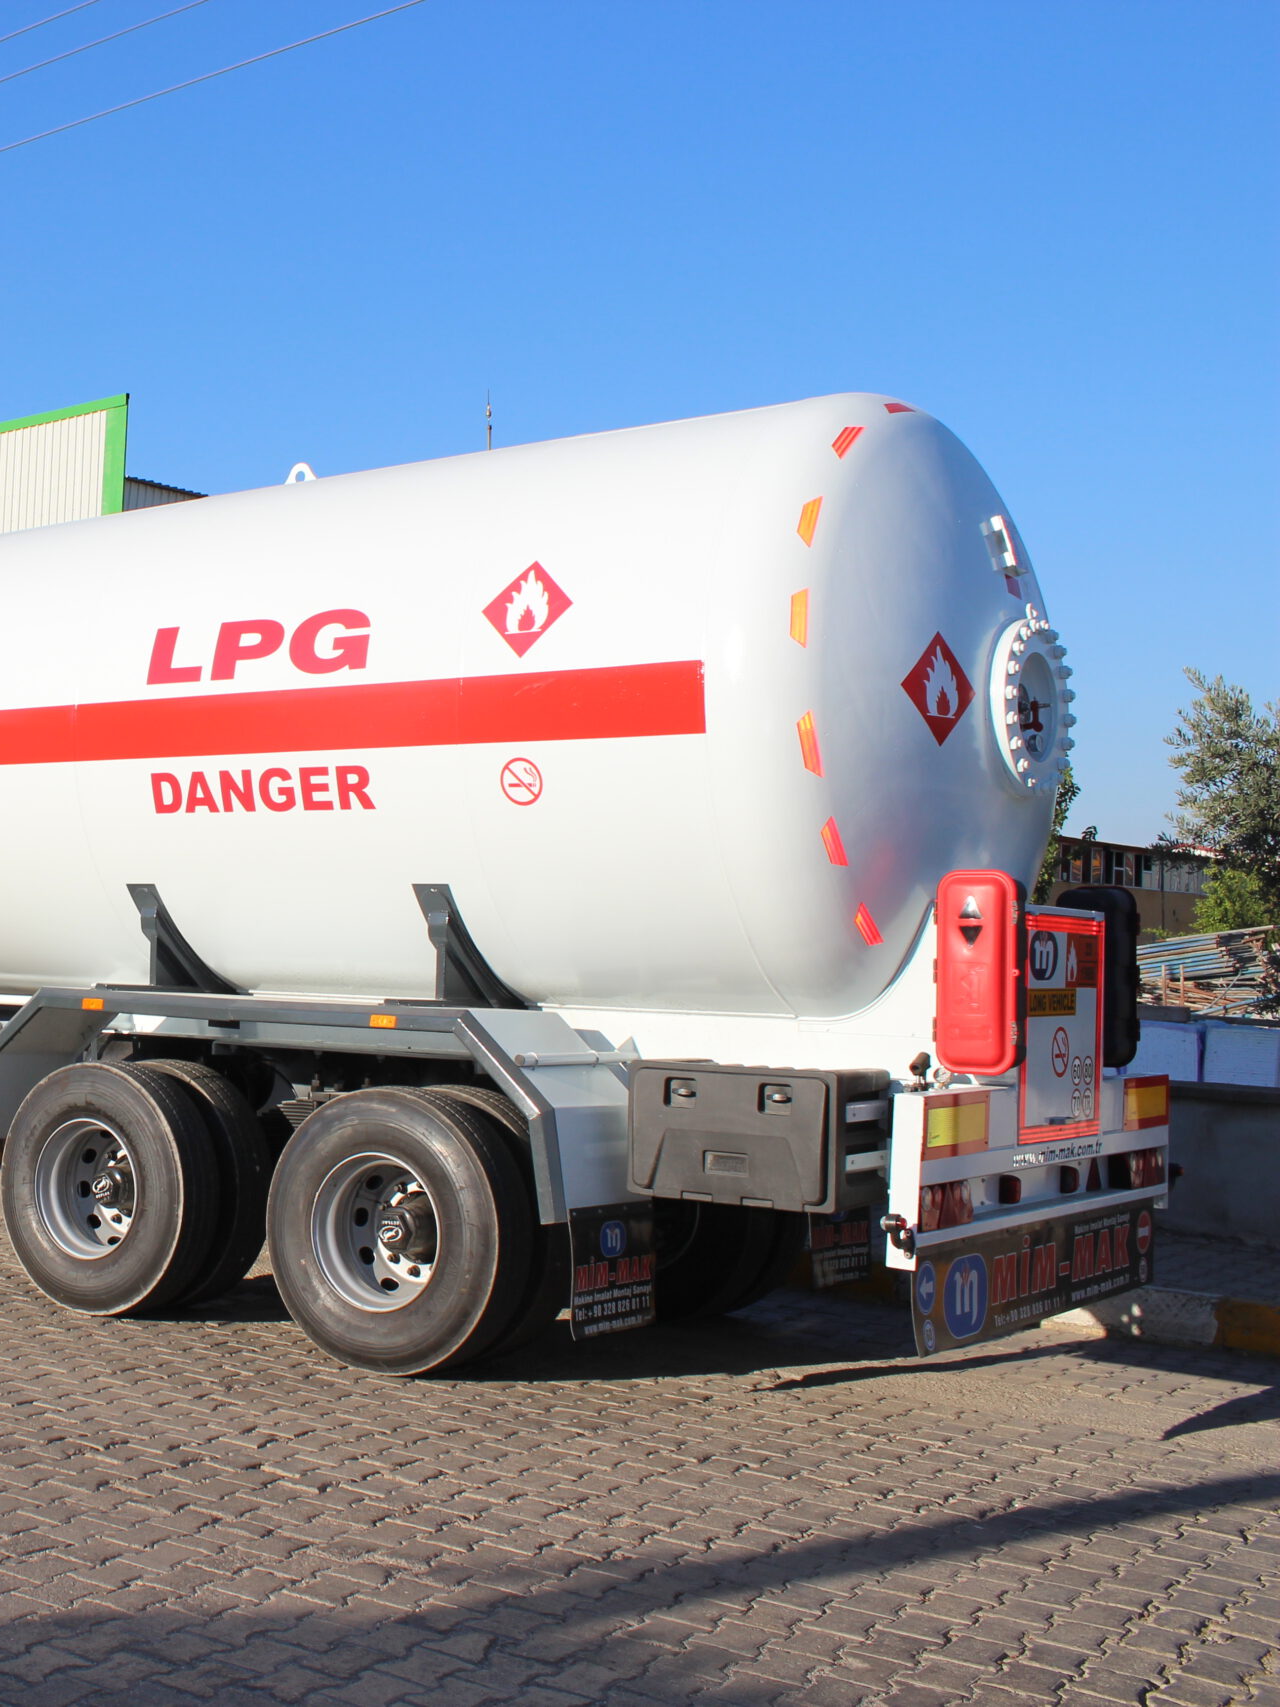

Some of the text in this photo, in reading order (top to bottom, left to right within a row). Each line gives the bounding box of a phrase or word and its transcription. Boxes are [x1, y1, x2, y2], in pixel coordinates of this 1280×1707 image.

[146, 608, 372, 686] LPG
[150, 765, 377, 815] DANGER
[1030, 993, 1074, 1012] LONG VEHICLE
